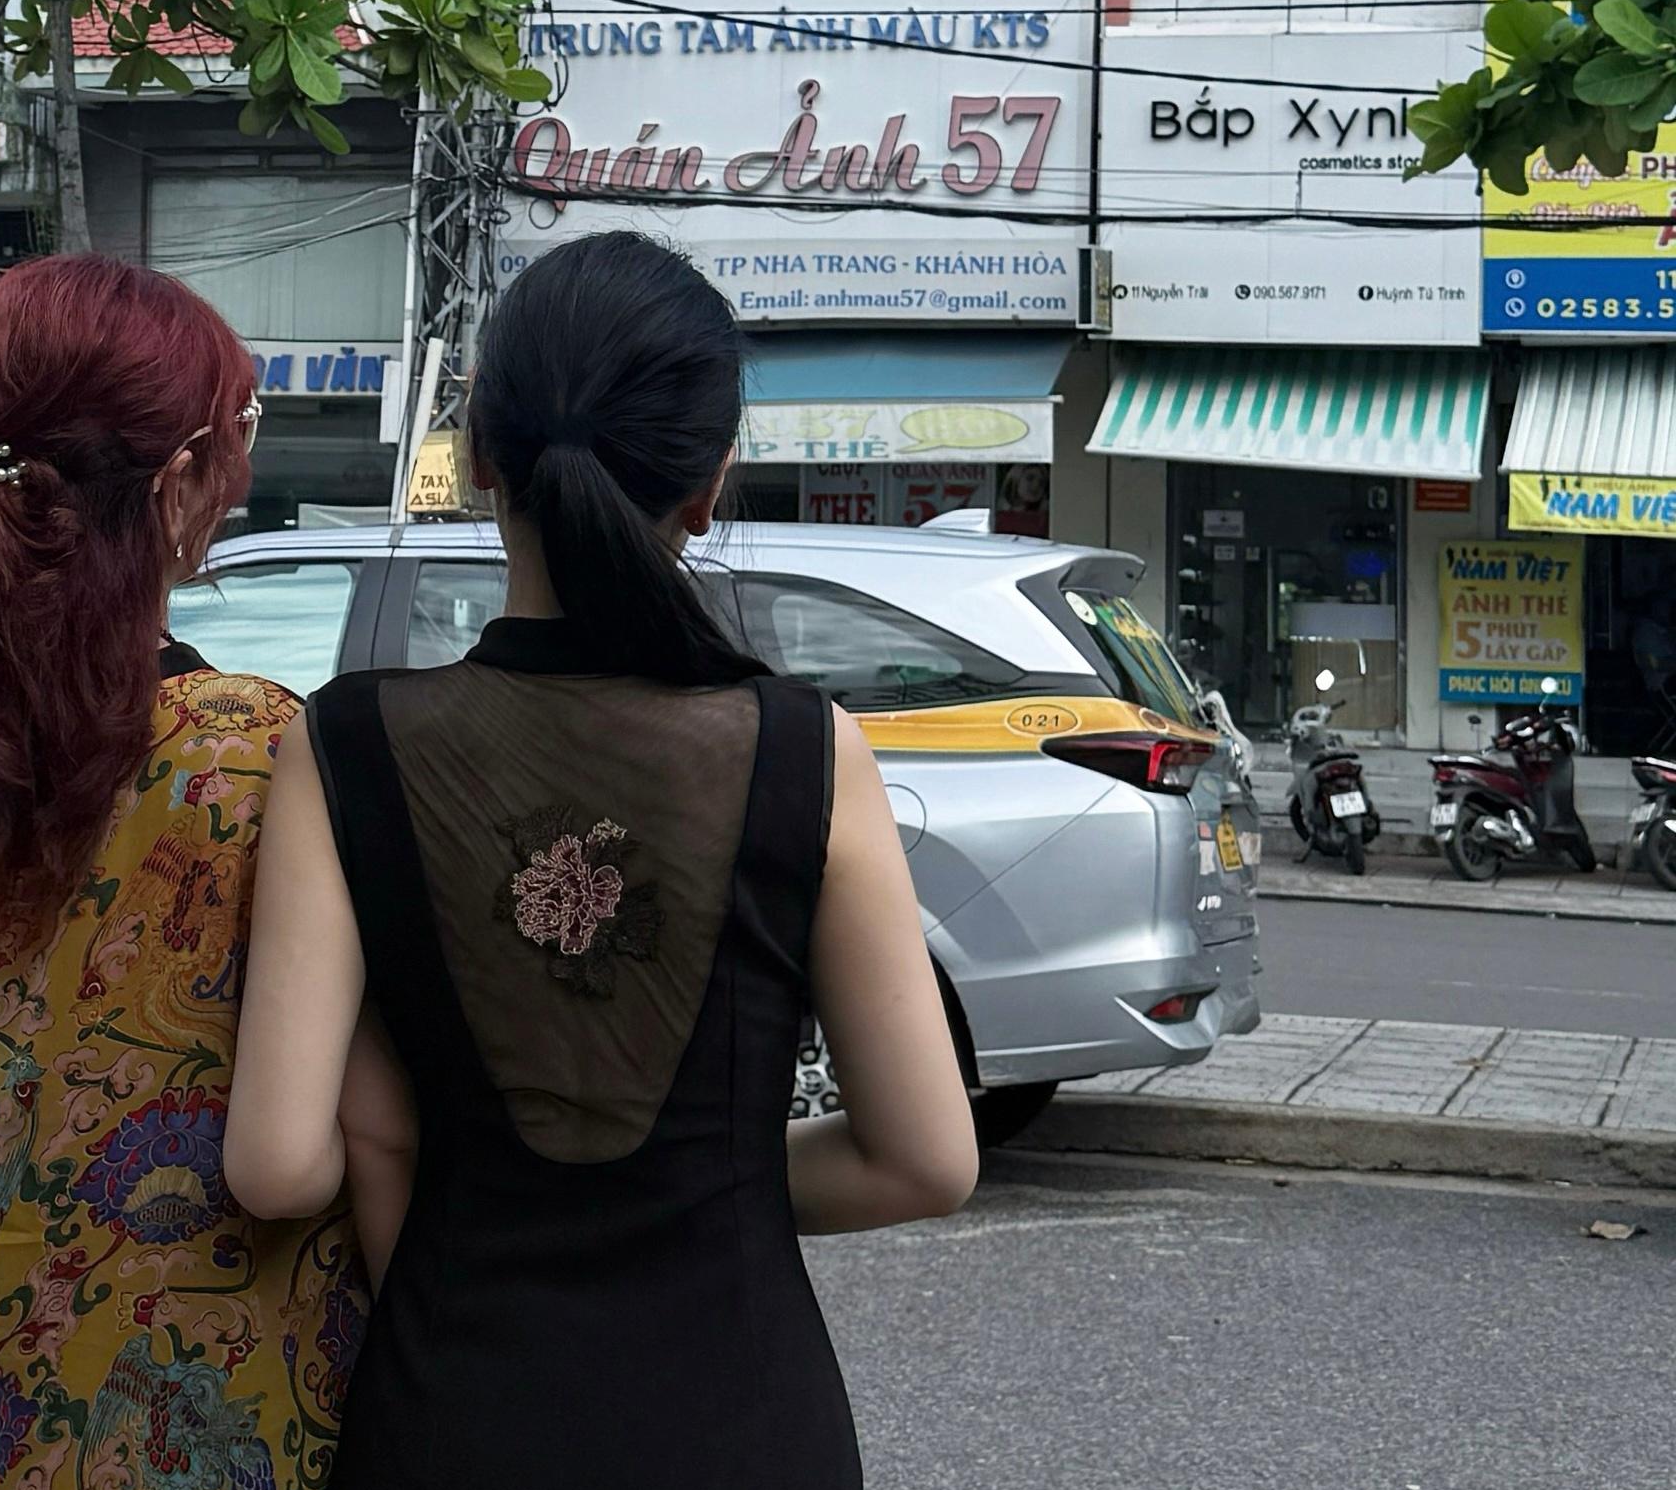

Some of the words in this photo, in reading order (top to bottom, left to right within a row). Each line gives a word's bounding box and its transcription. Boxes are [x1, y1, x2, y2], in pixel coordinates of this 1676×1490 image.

[530, 21, 662, 57] TRUNG
[972, 13, 1050, 48] KTS
[1150, 85, 1255, 148] Bắp
[513, 116, 711, 213] Quán
[723, 79, 928, 194] Ảnh
[940, 96, 1062, 198] 57
[1298, 155, 1382, 170] cosmetics
[714, 257, 747, 277] TP
[751, 252, 807, 275] NHA
[814, 252, 897, 276] TRANG
[915, 249, 1005, 276] KHÁNH
[1011, 250, 1067, 276] HÒA
[739, 290, 811, 310] Email:
[1547, 491, 1620, 521] NAM
[1452, 558, 1508, 581] NAM
[1455, 620, 1482, 660] 5
[1021, 713, 1061, 728] 021
